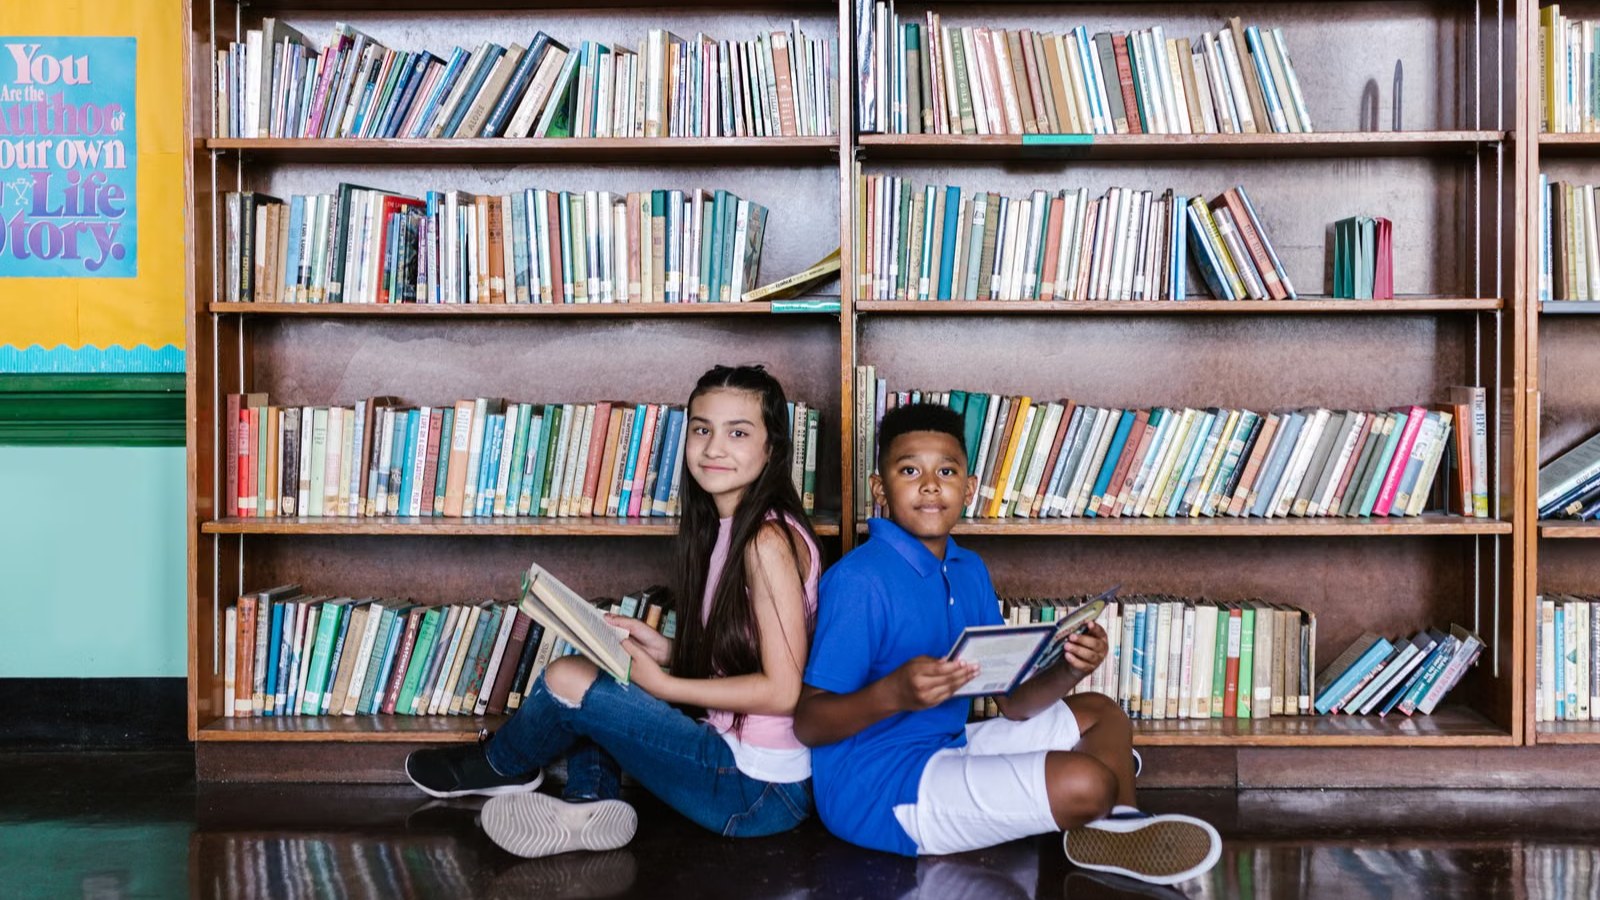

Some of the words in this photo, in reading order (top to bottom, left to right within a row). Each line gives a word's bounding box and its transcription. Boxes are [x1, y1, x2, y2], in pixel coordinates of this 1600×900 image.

[4, 44, 91, 85] You
[1, 84, 22, 101] Are
[25, 84, 45, 102] the
[111, 112, 126, 132] of
[468, 104, 484, 131] ALONE
[0, 139, 53, 170] our
[56, 139, 127, 170] own
[28, 171, 126, 218] Life
[1474, 392, 1485, 410] The
[622, 422, 631, 444] MYSTERY
[1474, 413, 1486, 436] BFG
